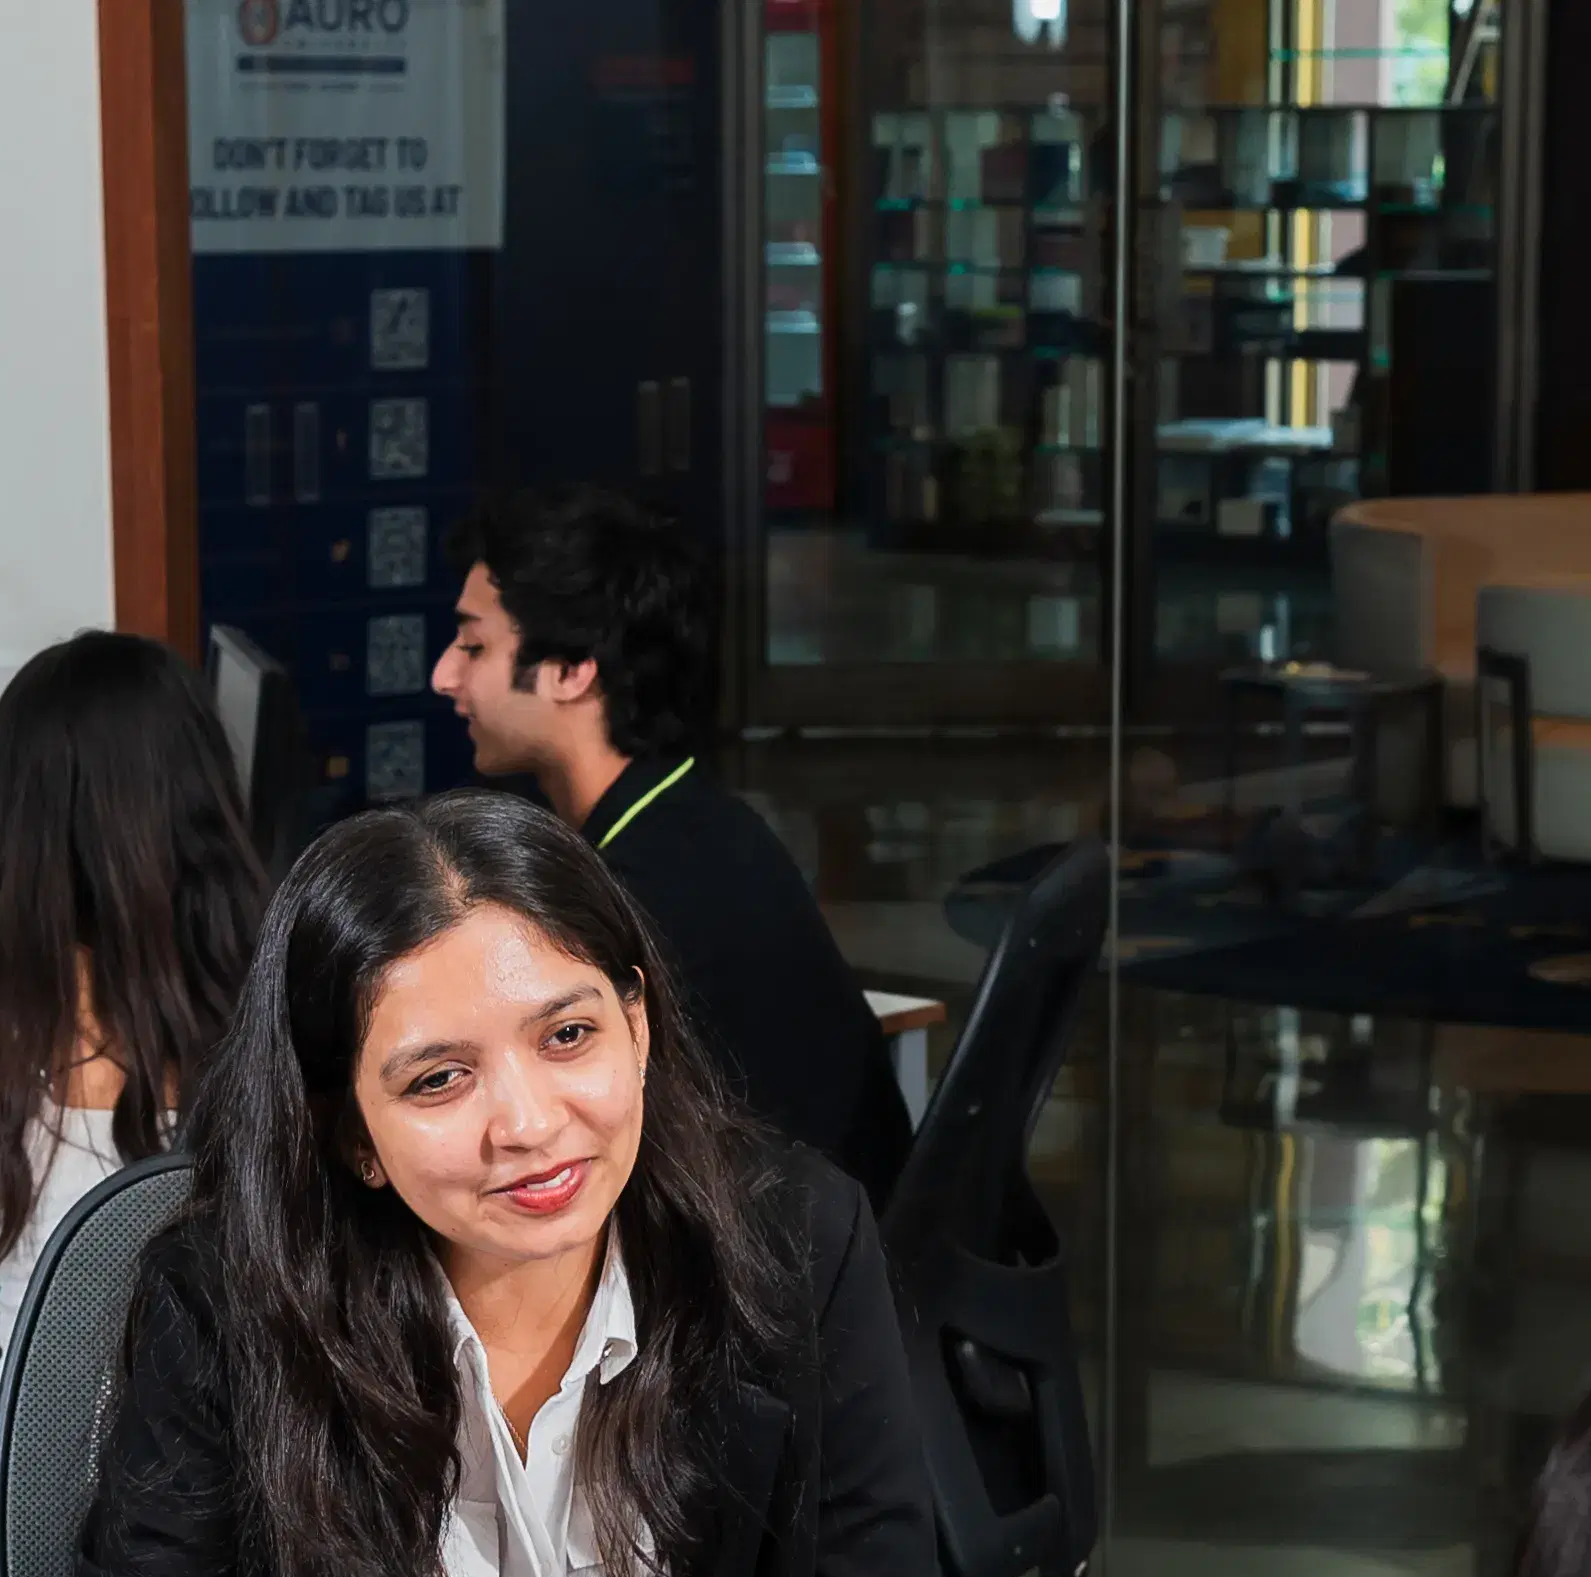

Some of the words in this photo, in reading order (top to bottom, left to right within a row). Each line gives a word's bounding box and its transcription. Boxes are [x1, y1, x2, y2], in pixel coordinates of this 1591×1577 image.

[284, 0, 410, 32] AURO
[212, 136, 285, 171] DON'T
[292, 136, 388, 172] FORGET
[395, 136, 429, 171] TO
[189, 185, 281, 219] OLLOW
[283, 185, 339, 218] AND
[340, 185, 390, 218] TAG
[392, 184, 427, 217] US
[430, 184, 464, 216] AT
